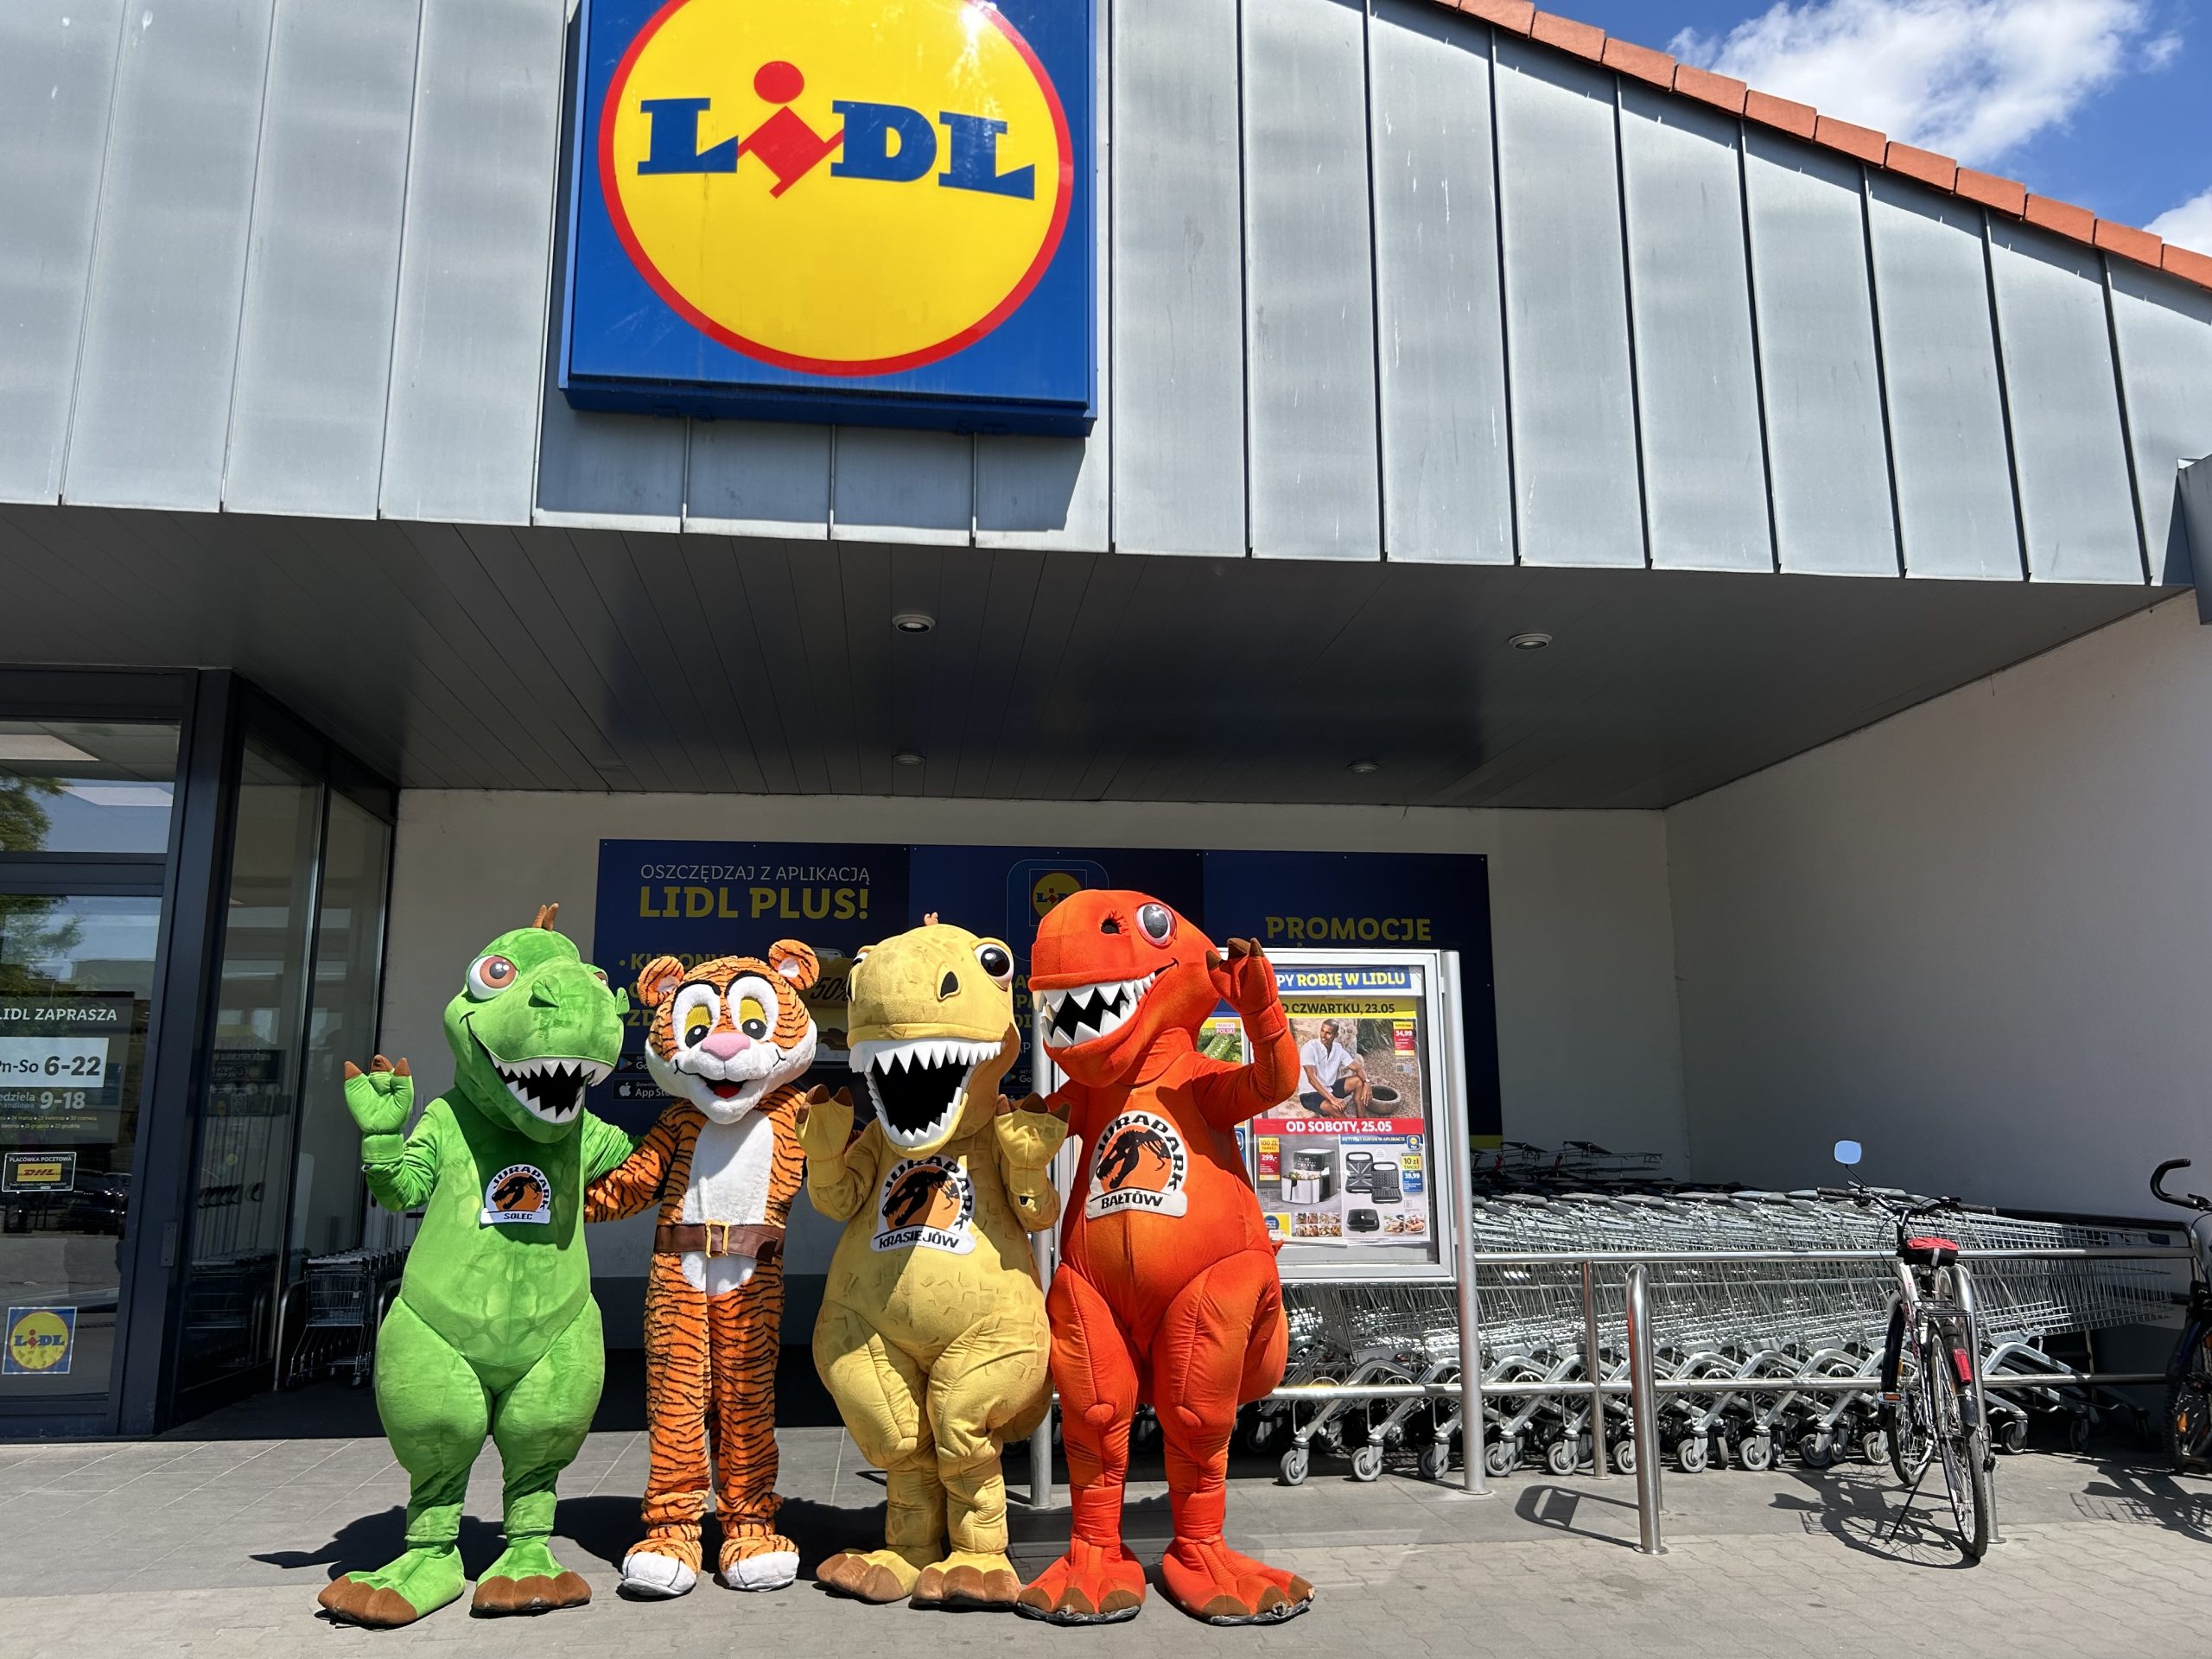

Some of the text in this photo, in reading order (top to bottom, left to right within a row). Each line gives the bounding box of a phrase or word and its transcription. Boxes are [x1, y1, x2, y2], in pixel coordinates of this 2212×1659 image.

[640, 864, 870, 885] OSZCZĘDZAJ Z APLIKACJĄ
[639, 886, 868, 919] LIDL PLUS!
[1265, 916, 1432, 941] PROMOCJE
[1297, 973, 1343, 988] ROBIĘ
[1344, 973, 1361, 985] W
[1363, 972, 1406, 985] LIDLU
[0, 1008, 118, 1021] IDL ZAPRASZA
[1292, 1003, 1363, 1015] CZWARTKU,
[1365, 1003, 1395, 1014] 23.05
[0, 1056, 102, 1076] n-So 6-22
[40, 1091, 86, 1109] 9-18
[635, 1089, 654, 1098] App
[1285, 1121, 1392, 1134] OD SOBOTY, 25.05
[1097, 1114, 1184, 1192] JURAPARK
[493, 1166, 550, 1211] JURAPARK
[1101, 1191, 1164, 1210] BAŁTÓW
[879, 1230, 960, 1249] KRASIEJÓW
